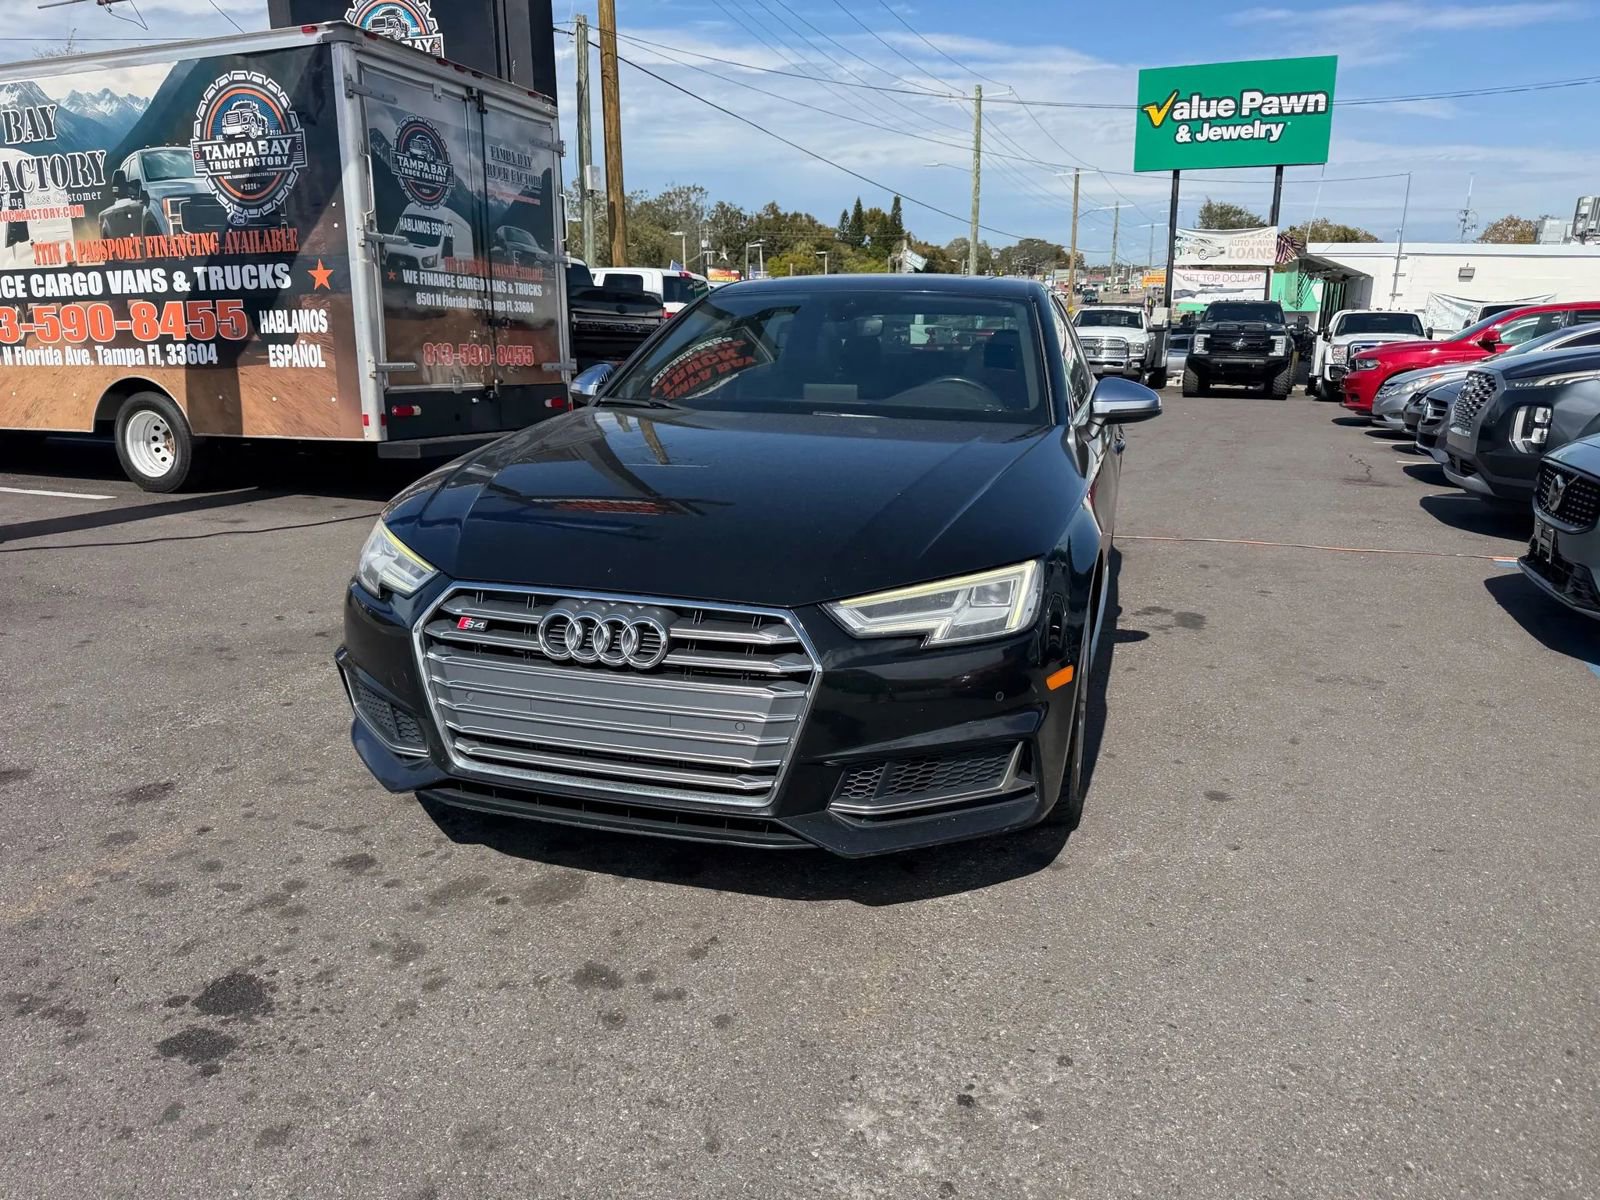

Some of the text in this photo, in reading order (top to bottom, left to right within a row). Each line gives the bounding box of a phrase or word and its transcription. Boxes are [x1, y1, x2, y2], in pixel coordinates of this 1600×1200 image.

[1144, 90, 1327, 127] Value Pawn
[2, 104, 57, 144] BAY
[1174, 120, 1286, 143] & Jewelry
[201, 139, 293, 161] TAMPA BAY
[0, 150, 107, 194] ACTORY
[208, 155, 289, 171] TRUCK FACTORY
[397, 155, 448, 178] TAMPA BAY
[401, 166, 447, 182] TRUCK FACTORY
[400, 217, 430, 235] HABLAMOS
[32, 227, 299, 266] ITIN & PASSPORT FINANCING AVAILABLE
[1228, 247, 1275, 259] LOANS
[0, 263, 292, 298] CE CARGO VANS & TRUCKS
[402, 269, 418, 284] WE
[419, 271, 455, 290] FINANCE
[515, 282, 543, 297] TRUCKS
[1182, 274, 1260, 282] GET TOP DOLLAR
[416, 291, 436, 306] 8501
[0, 299, 248, 344] 3-590-8455
[258, 309, 329, 334] HABLAMOS
[3, 346, 13, 366] N
[14, 345, 63, 366] Florida
[64, 345, 94, 366] Ave.
[95, 345, 146, 367] Tampa
[166, 343, 218, 365] 33604
[268, 339, 326, 368] ESPAÑOL
[423, 342, 534, 367] 813-590-8455
